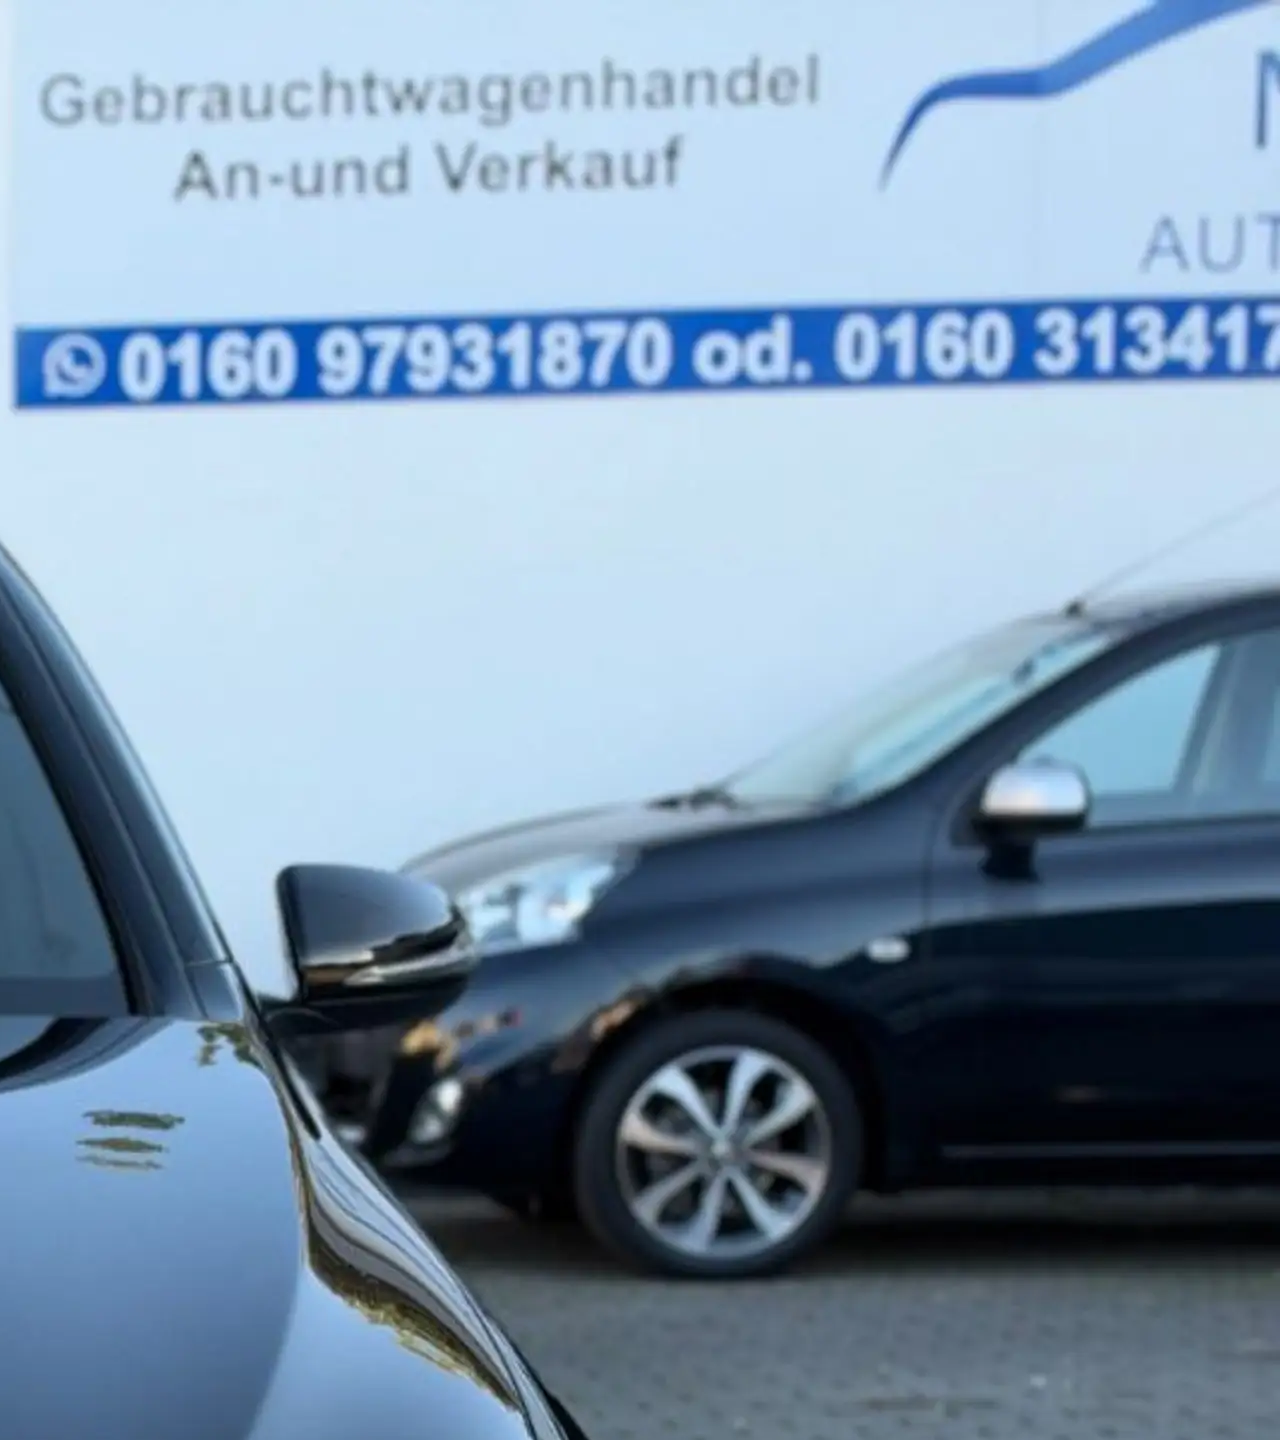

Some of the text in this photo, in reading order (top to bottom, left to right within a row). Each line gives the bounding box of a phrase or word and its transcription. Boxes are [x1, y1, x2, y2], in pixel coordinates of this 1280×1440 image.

[38, 55, 820, 126] Gebrauchtwagenhandel
[172, 134, 682, 200] An-und Verkauf
[119, 332, 295, 396] 0160
[316, 321, 672, 392] 97931870
[693, 318, 813, 383] od.
[834, 315, 1012, 379] 0160
